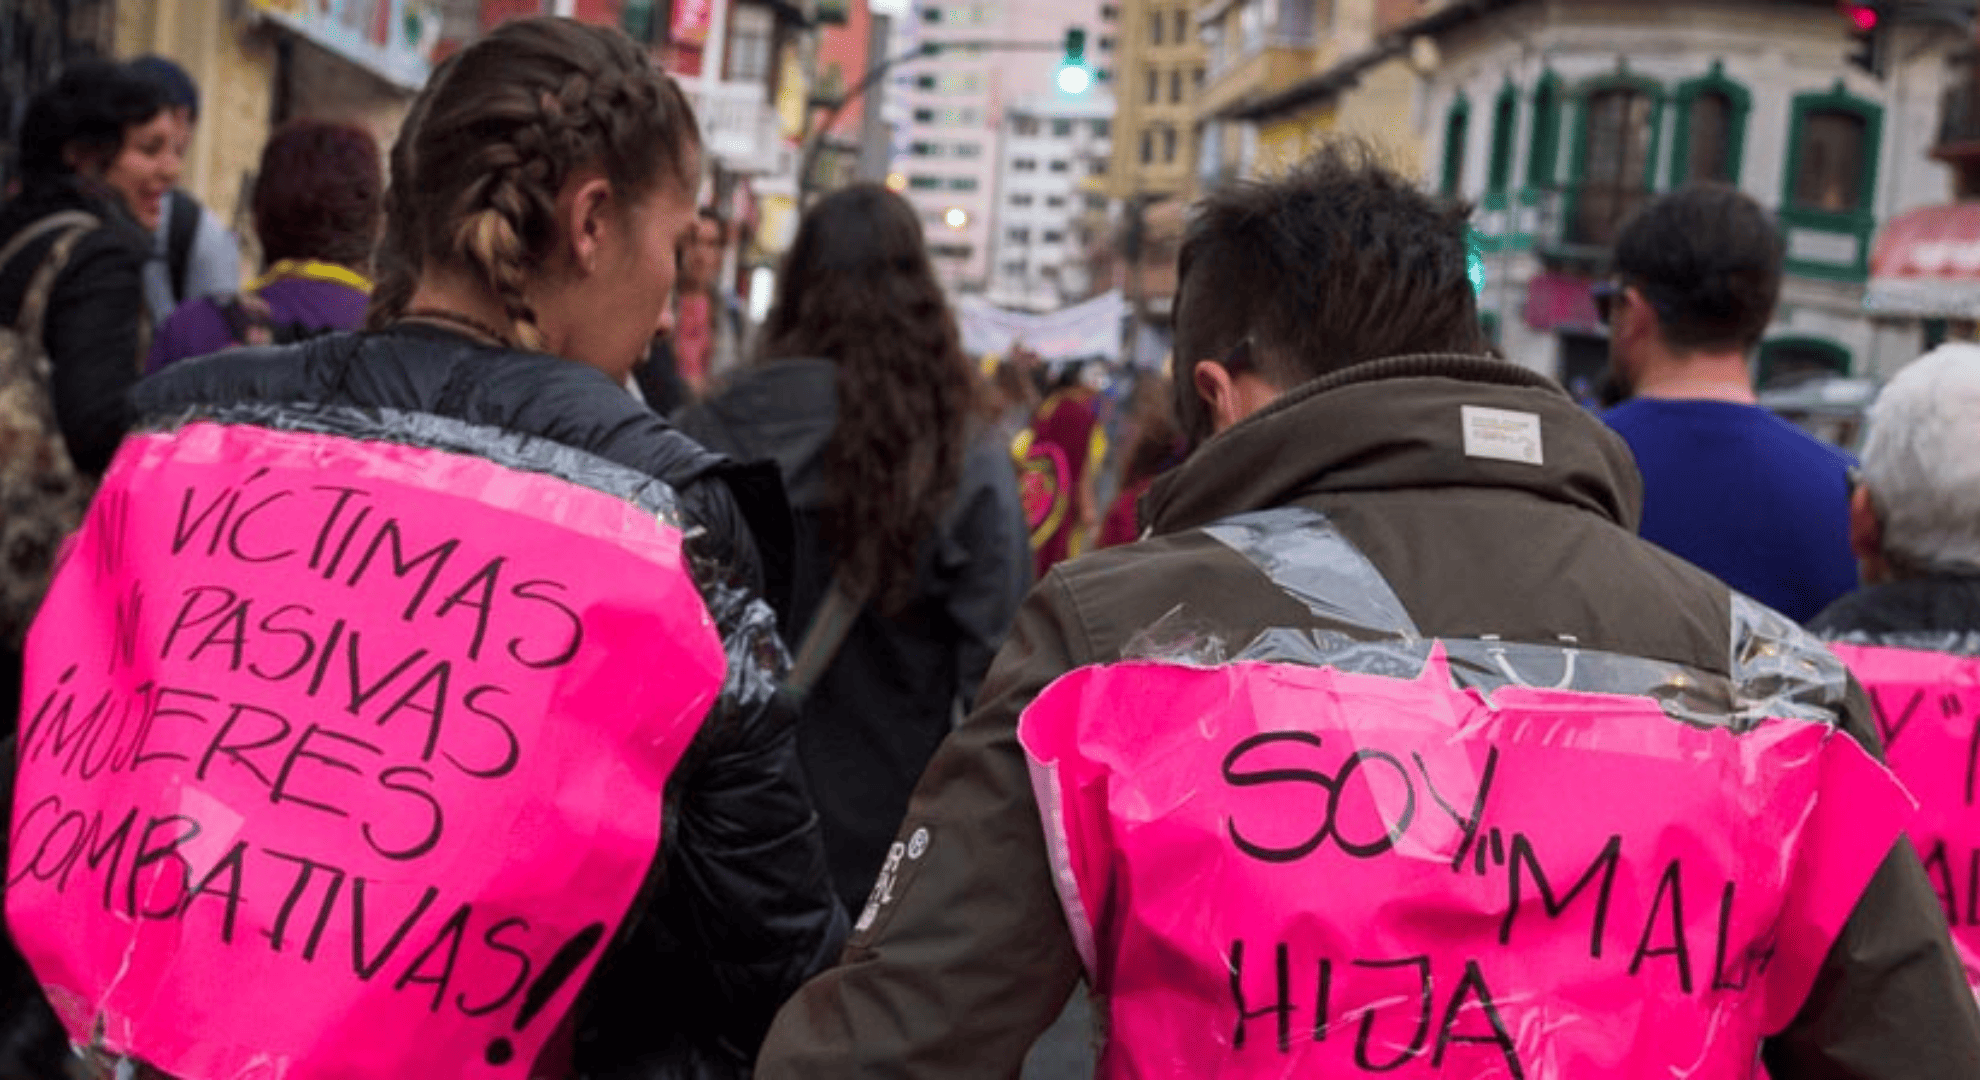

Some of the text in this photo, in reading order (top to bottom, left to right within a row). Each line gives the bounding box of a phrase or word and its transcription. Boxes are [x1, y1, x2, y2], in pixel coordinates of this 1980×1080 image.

[169, 467, 584, 669] VÍCTIMAS
[159, 585, 520, 778] PASIVAS
[1222, 730, 1498, 873] SOY
[5, 795, 606, 1065] COMBATIVAS!
[1229, 939, 1524, 1080] HIJA
